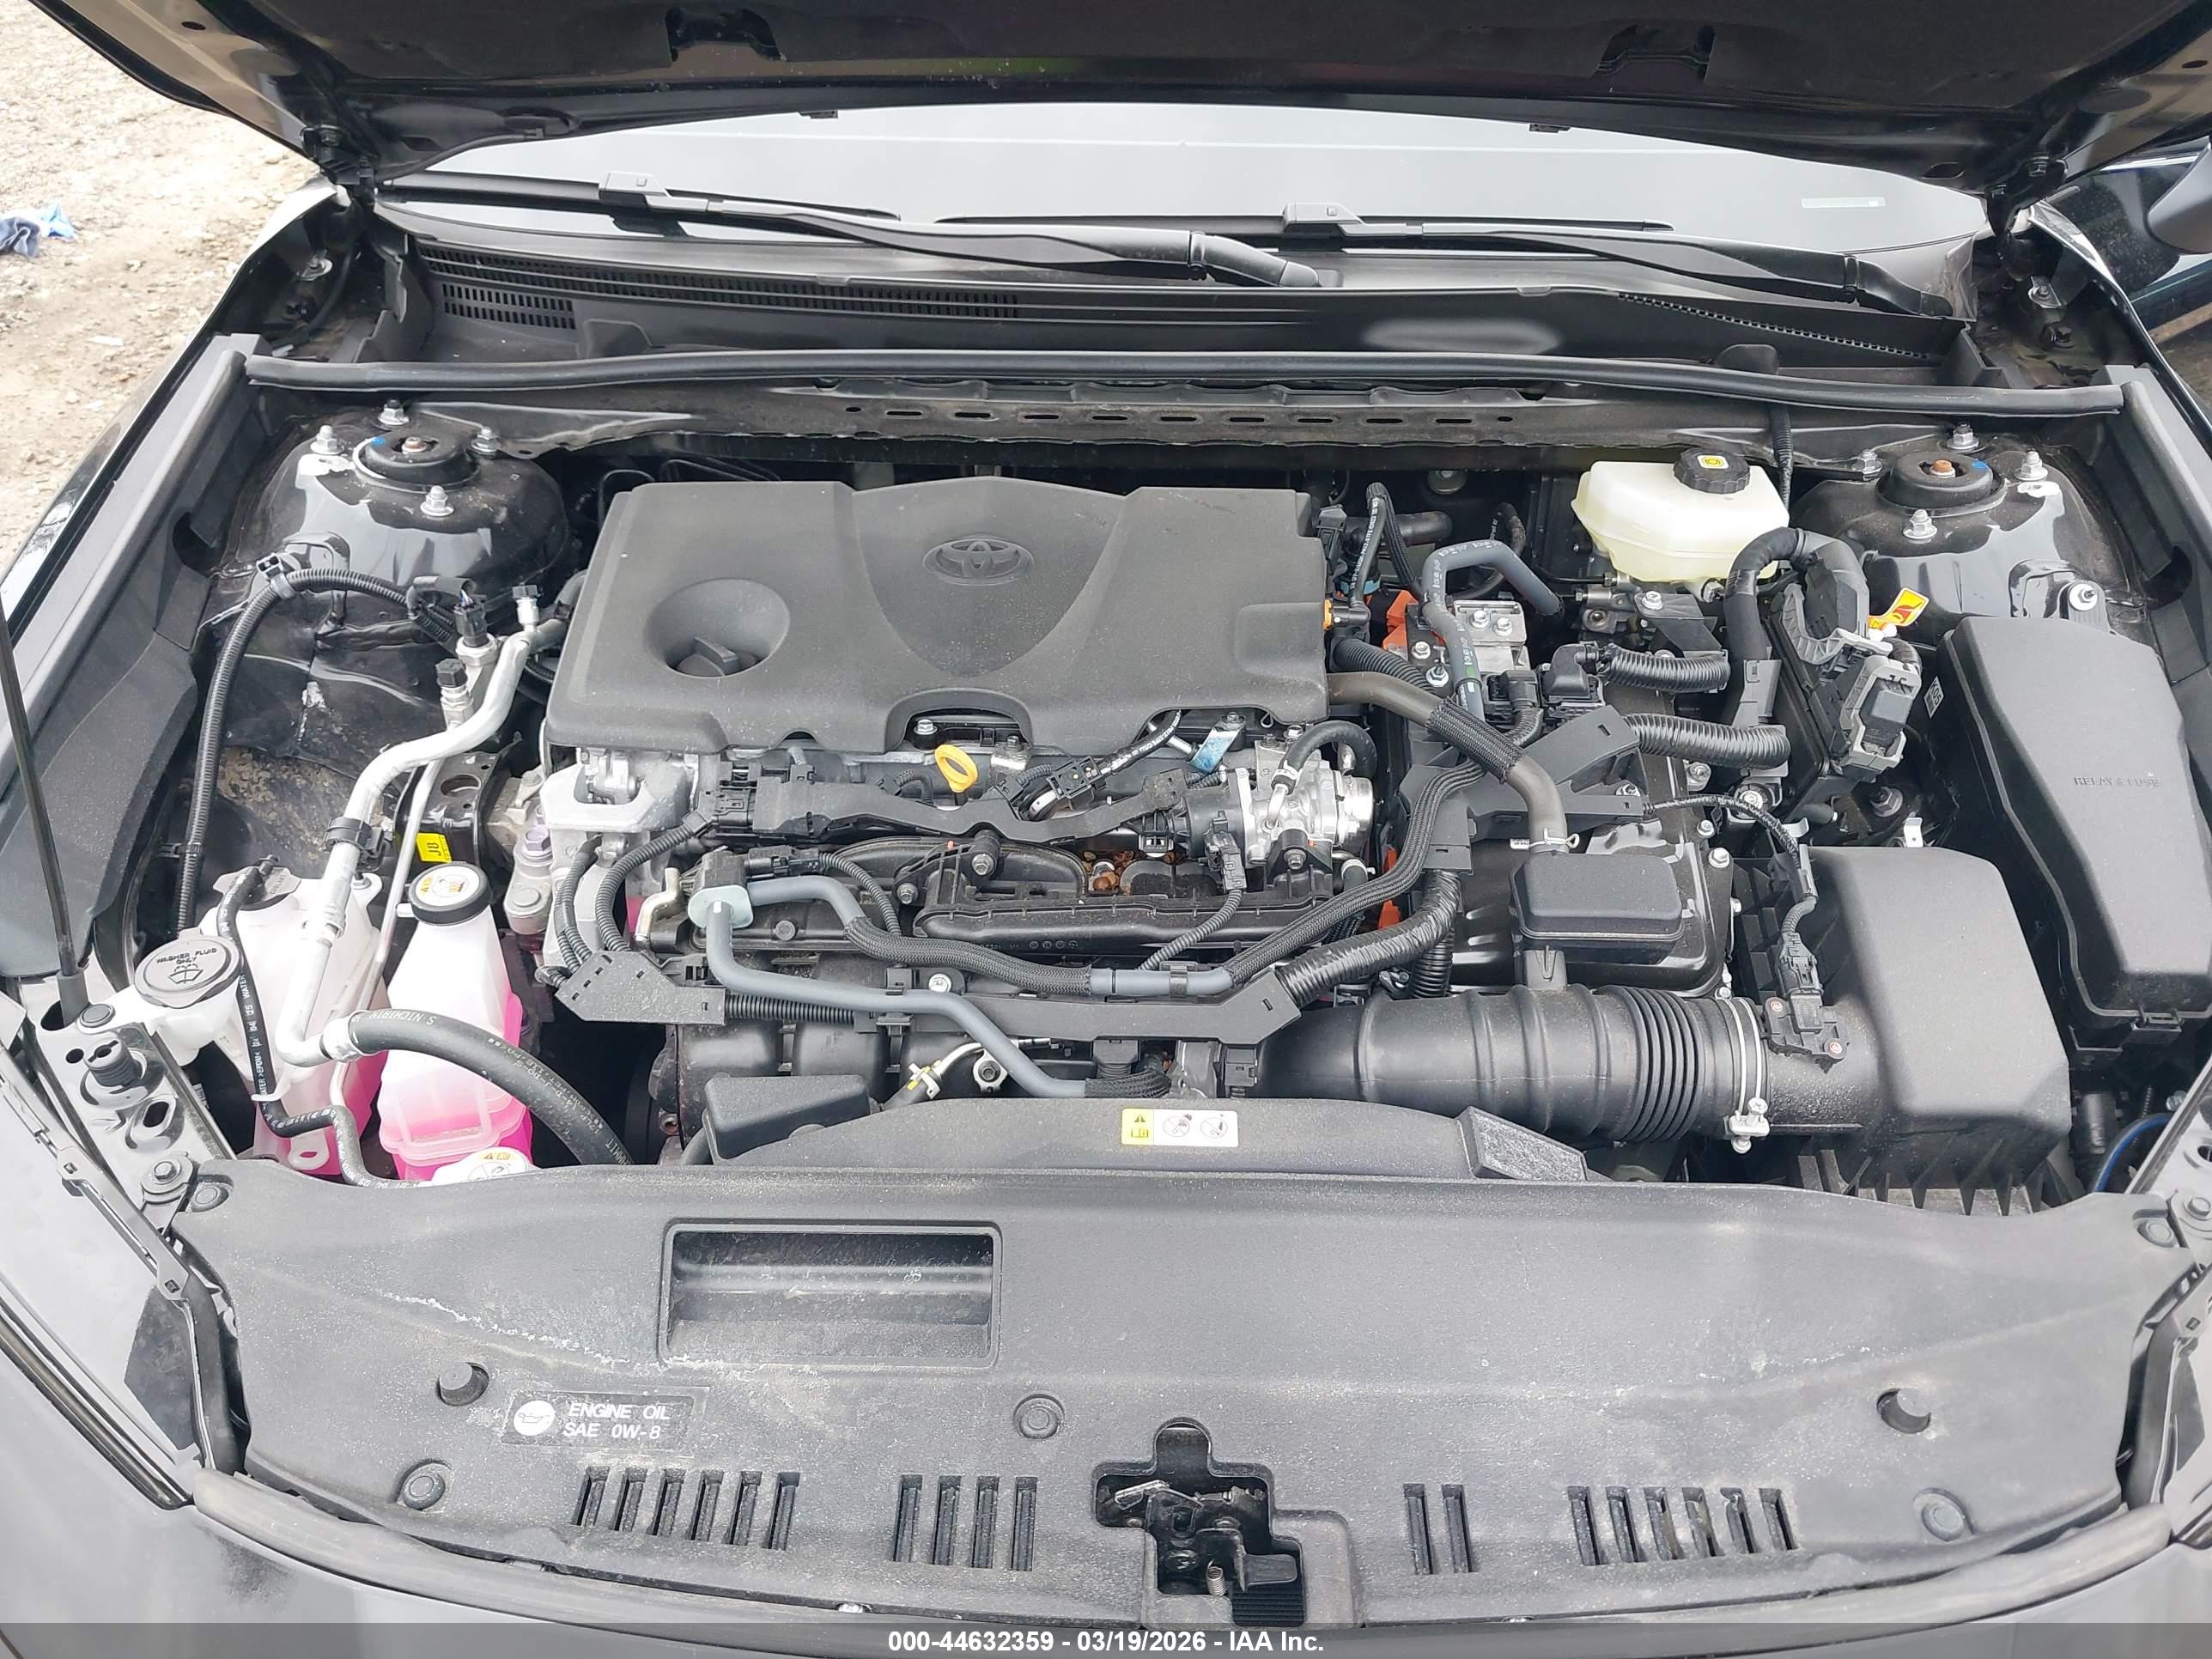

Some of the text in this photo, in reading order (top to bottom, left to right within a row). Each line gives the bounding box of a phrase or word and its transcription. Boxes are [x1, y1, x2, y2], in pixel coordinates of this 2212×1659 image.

[568, 1401, 671, 1420] ENGINE OIL
[562, 1422, 662, 1440] SAE 0W-8
